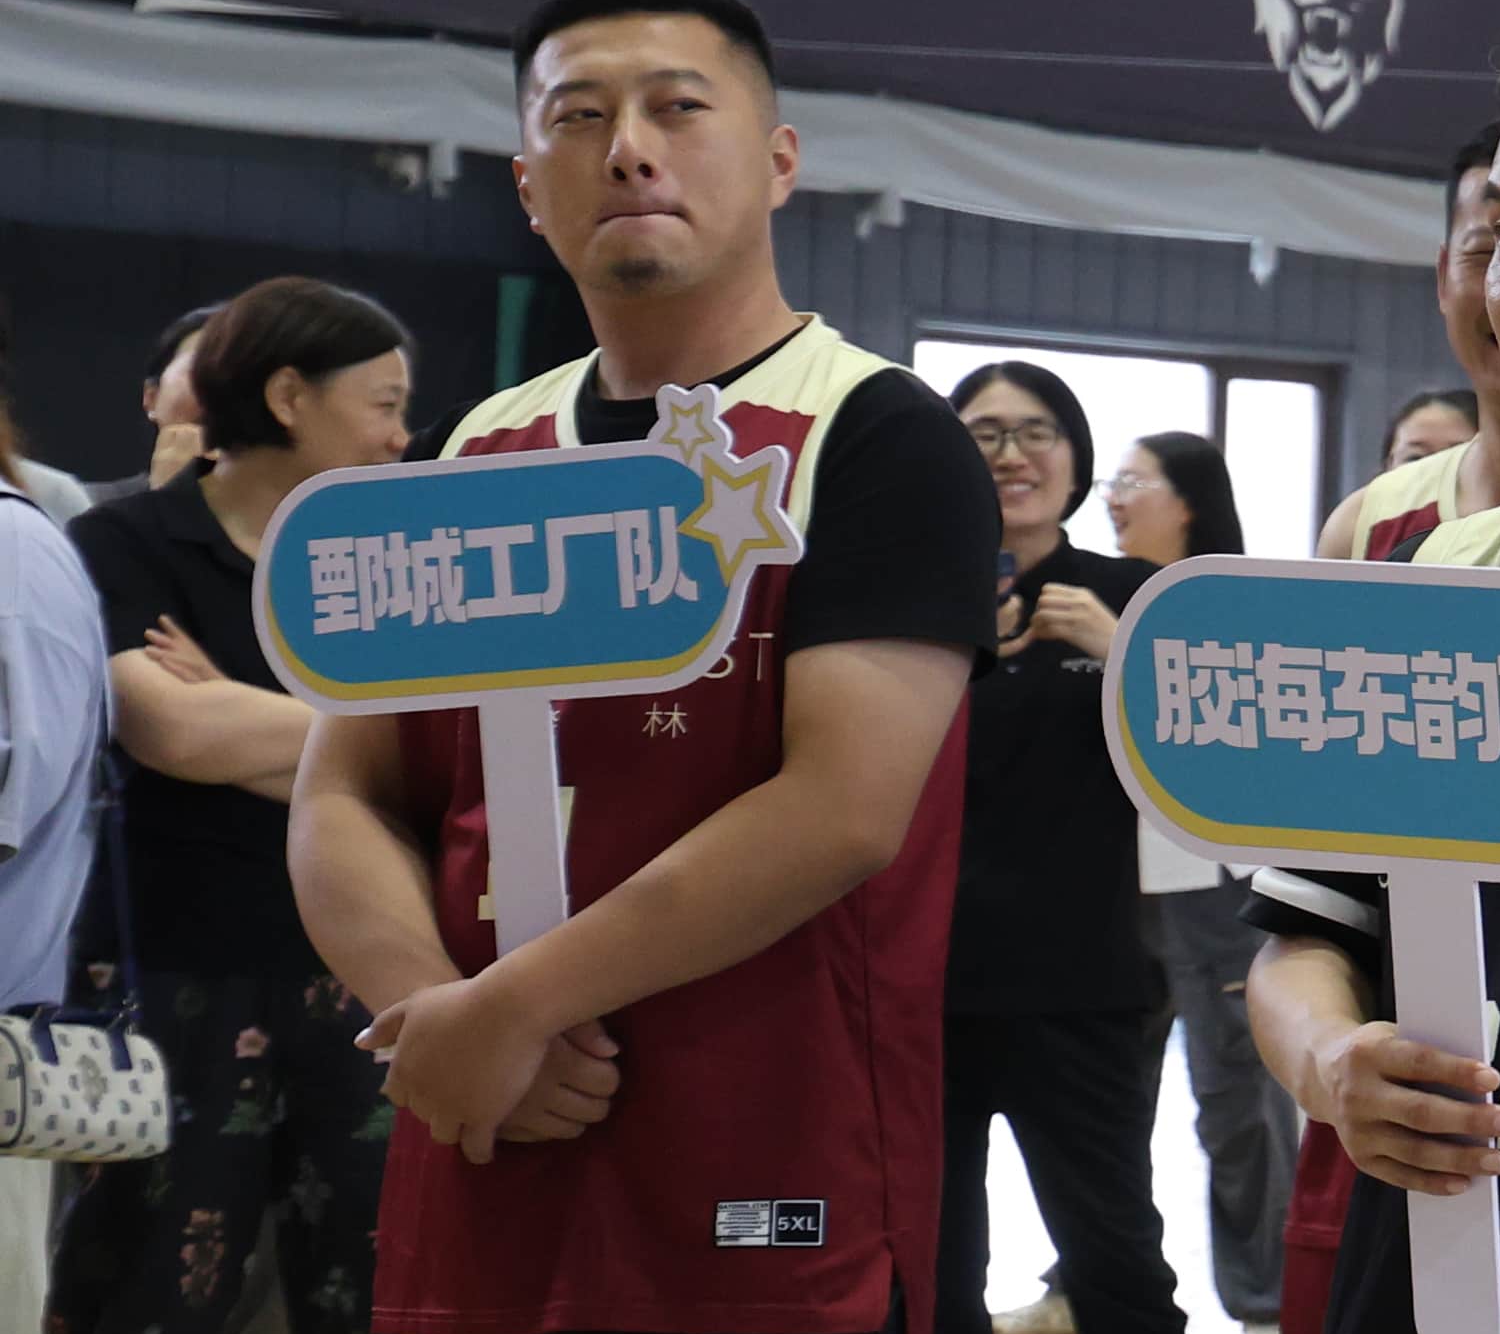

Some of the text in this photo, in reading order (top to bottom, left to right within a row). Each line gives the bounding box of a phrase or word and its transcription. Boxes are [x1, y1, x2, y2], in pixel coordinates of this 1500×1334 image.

[307, 506, 698, 635] 鄄城工厂队
[642, 702, 687, 738] 林
[777, 1216, 817, 1231] 5XL
